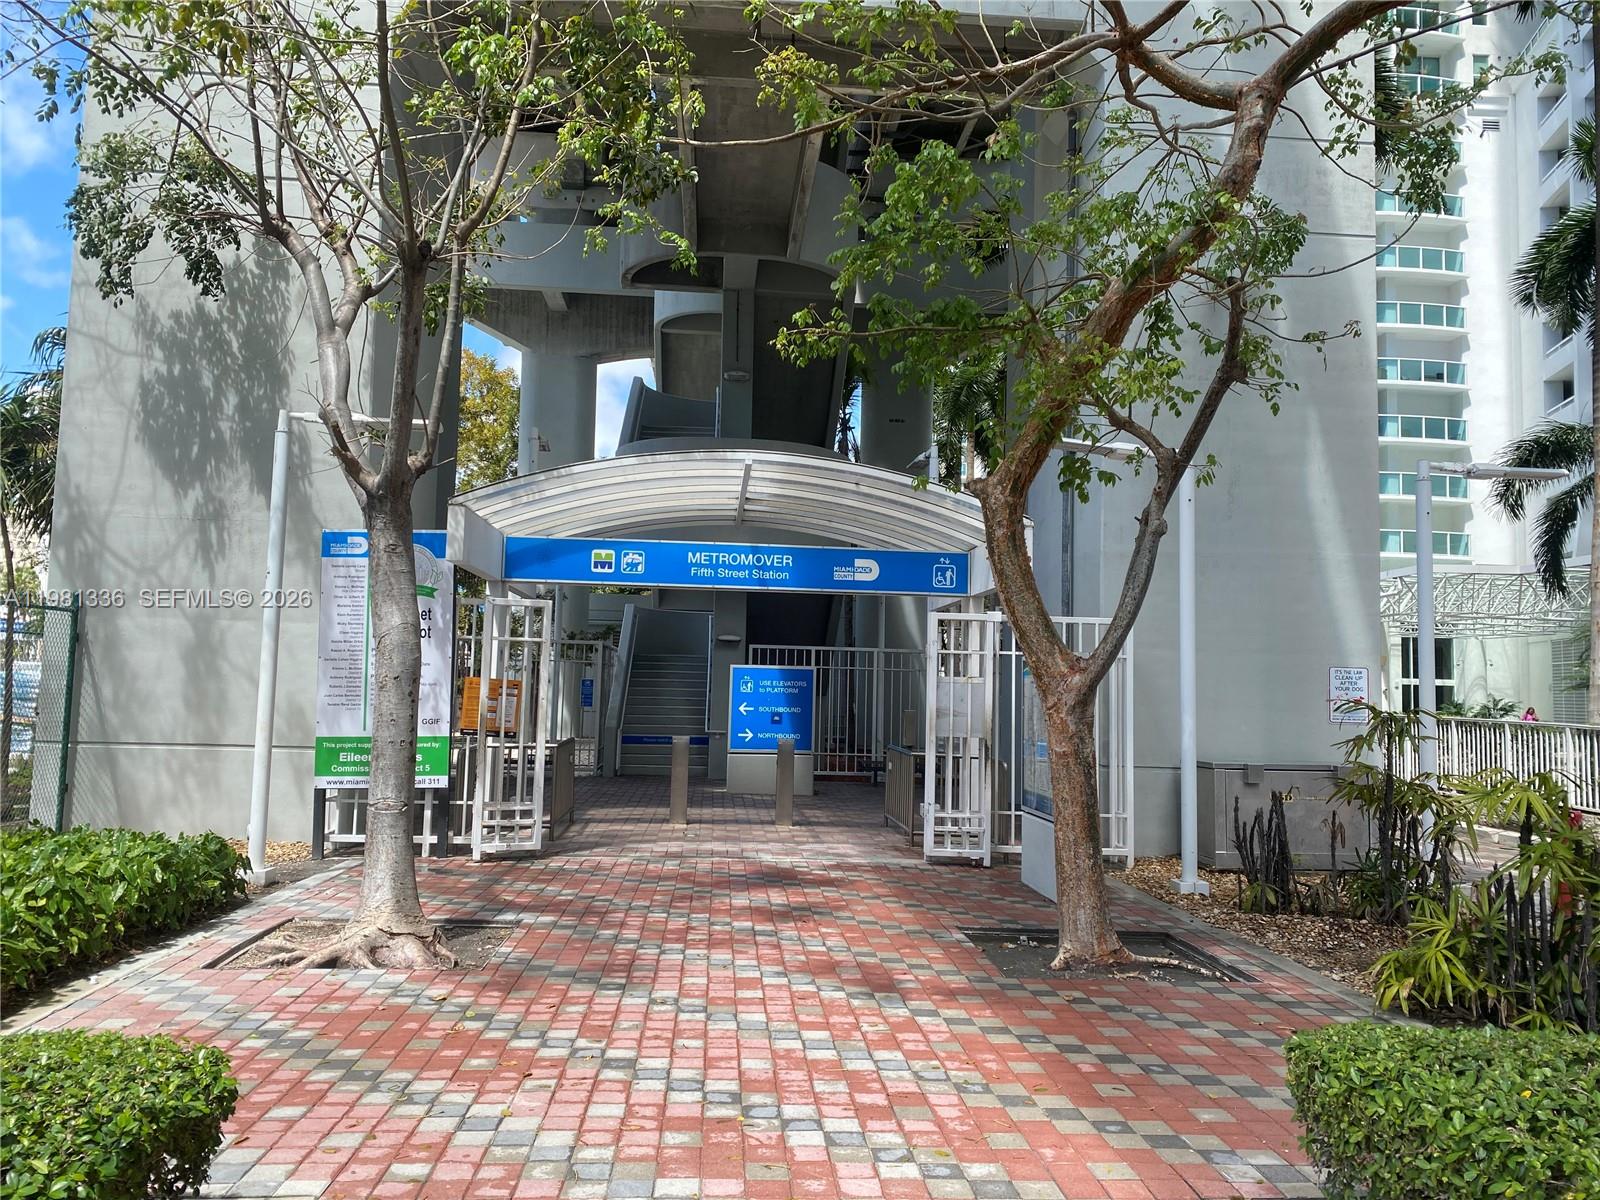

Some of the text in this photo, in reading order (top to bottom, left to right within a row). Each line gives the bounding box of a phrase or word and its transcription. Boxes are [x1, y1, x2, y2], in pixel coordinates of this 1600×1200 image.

[687, 551, 793, 567] METROMOVER
[691, 567, 789, 580] Fifth Street Station
[331, 764, 370, 772] Commiss
[424, 764, 431, 772] 5
